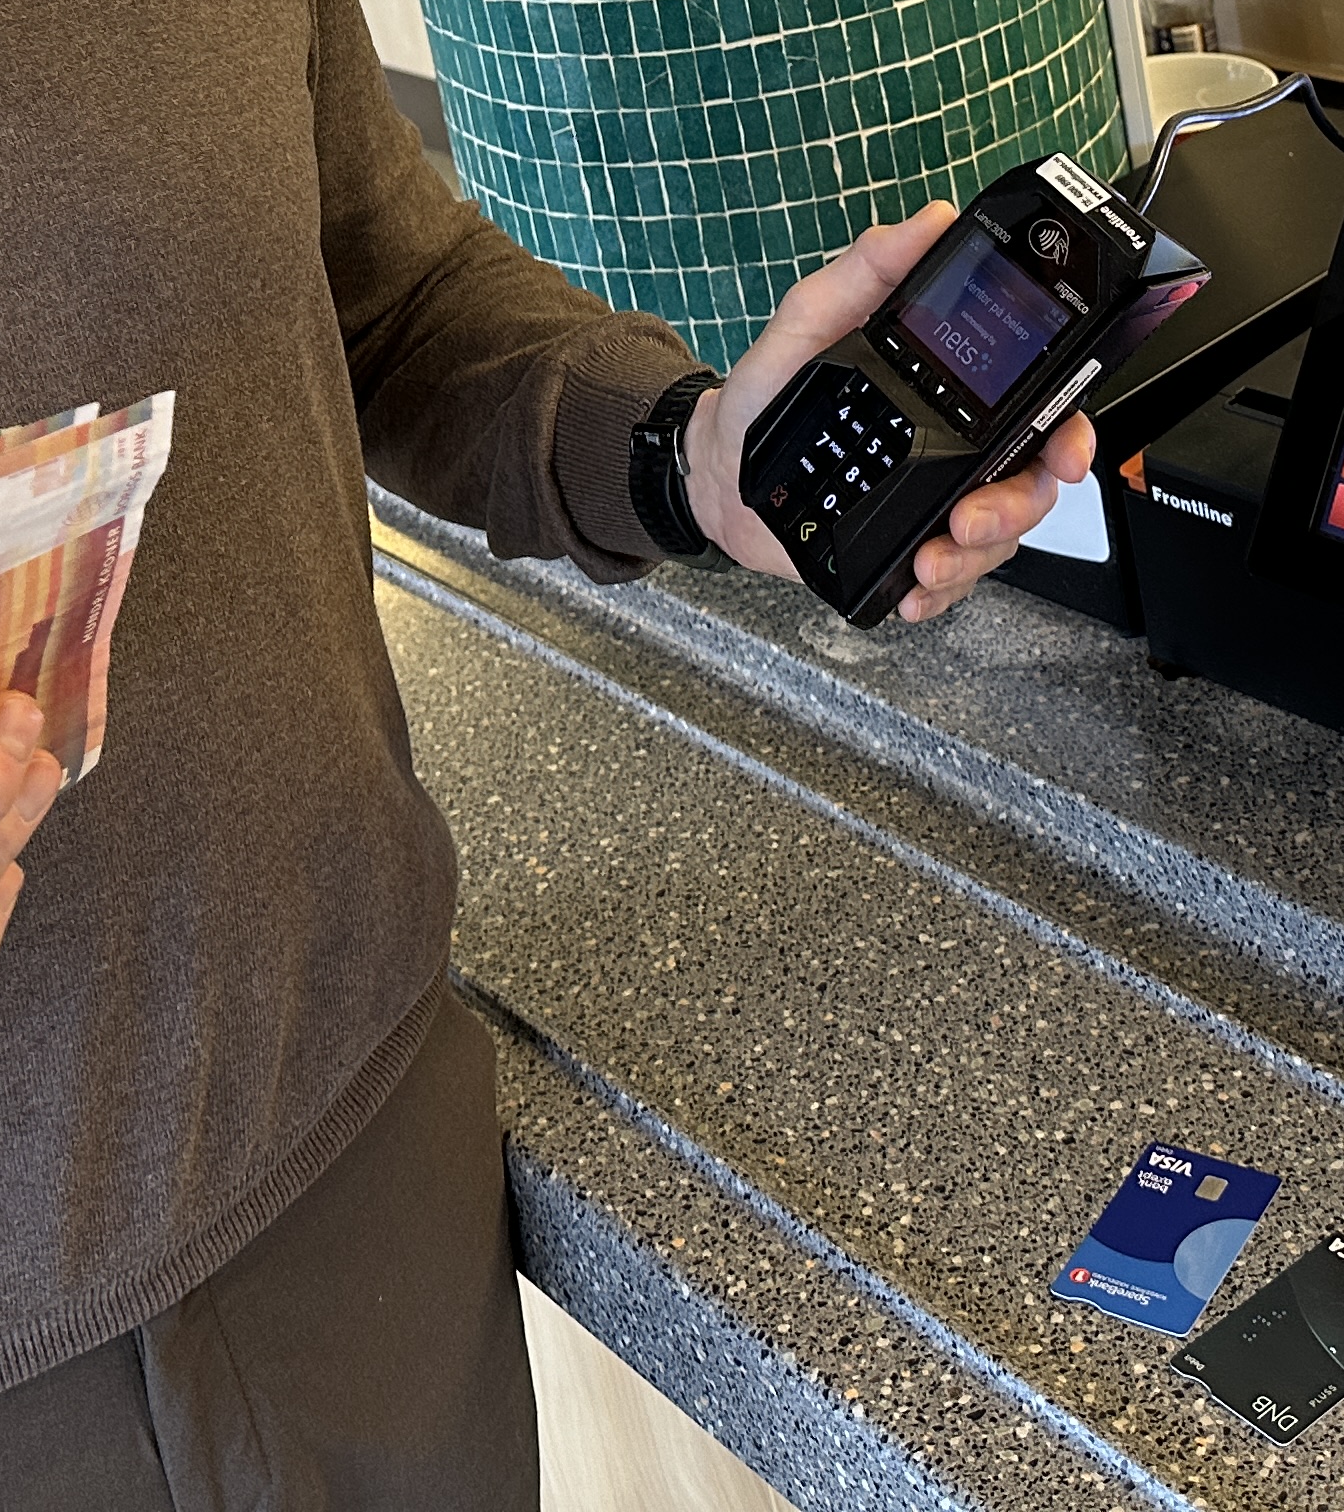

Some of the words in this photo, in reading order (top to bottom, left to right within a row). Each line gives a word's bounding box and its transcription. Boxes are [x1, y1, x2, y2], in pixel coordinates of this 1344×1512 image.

[973, 208, 1012, 244] Lane/3000
[1100, 205, 1147, 251] Frontline
[1054, 279, 1090, 315] ingenico
[933, 318, 978, 367] nets
[838, 405, 851, 421] 4
[131, 428, 148, 471] BANK
[815, 431, 831, 447] 7
[866, 437, 882, 455] 5
[845, 465, 860, 483] 8
[823, 493, 837, 510] 0
[1151, 485, 1234, 528] Frontline
[97, 525, 122, 587] KRONER
[1137, 1169, 1173, 1186] axept
[1148, 1151, 1192, 1178] VISA
[1138, 1178, 1169, 1194] bank
[1087, 1277, 1152, 1305] SpareBank
[1183, 1353, 1207, 1371] Debit
[1308, 1383, 1338, 1408] PLUSS
[1251, 1395, 1299, 1432] DNB
